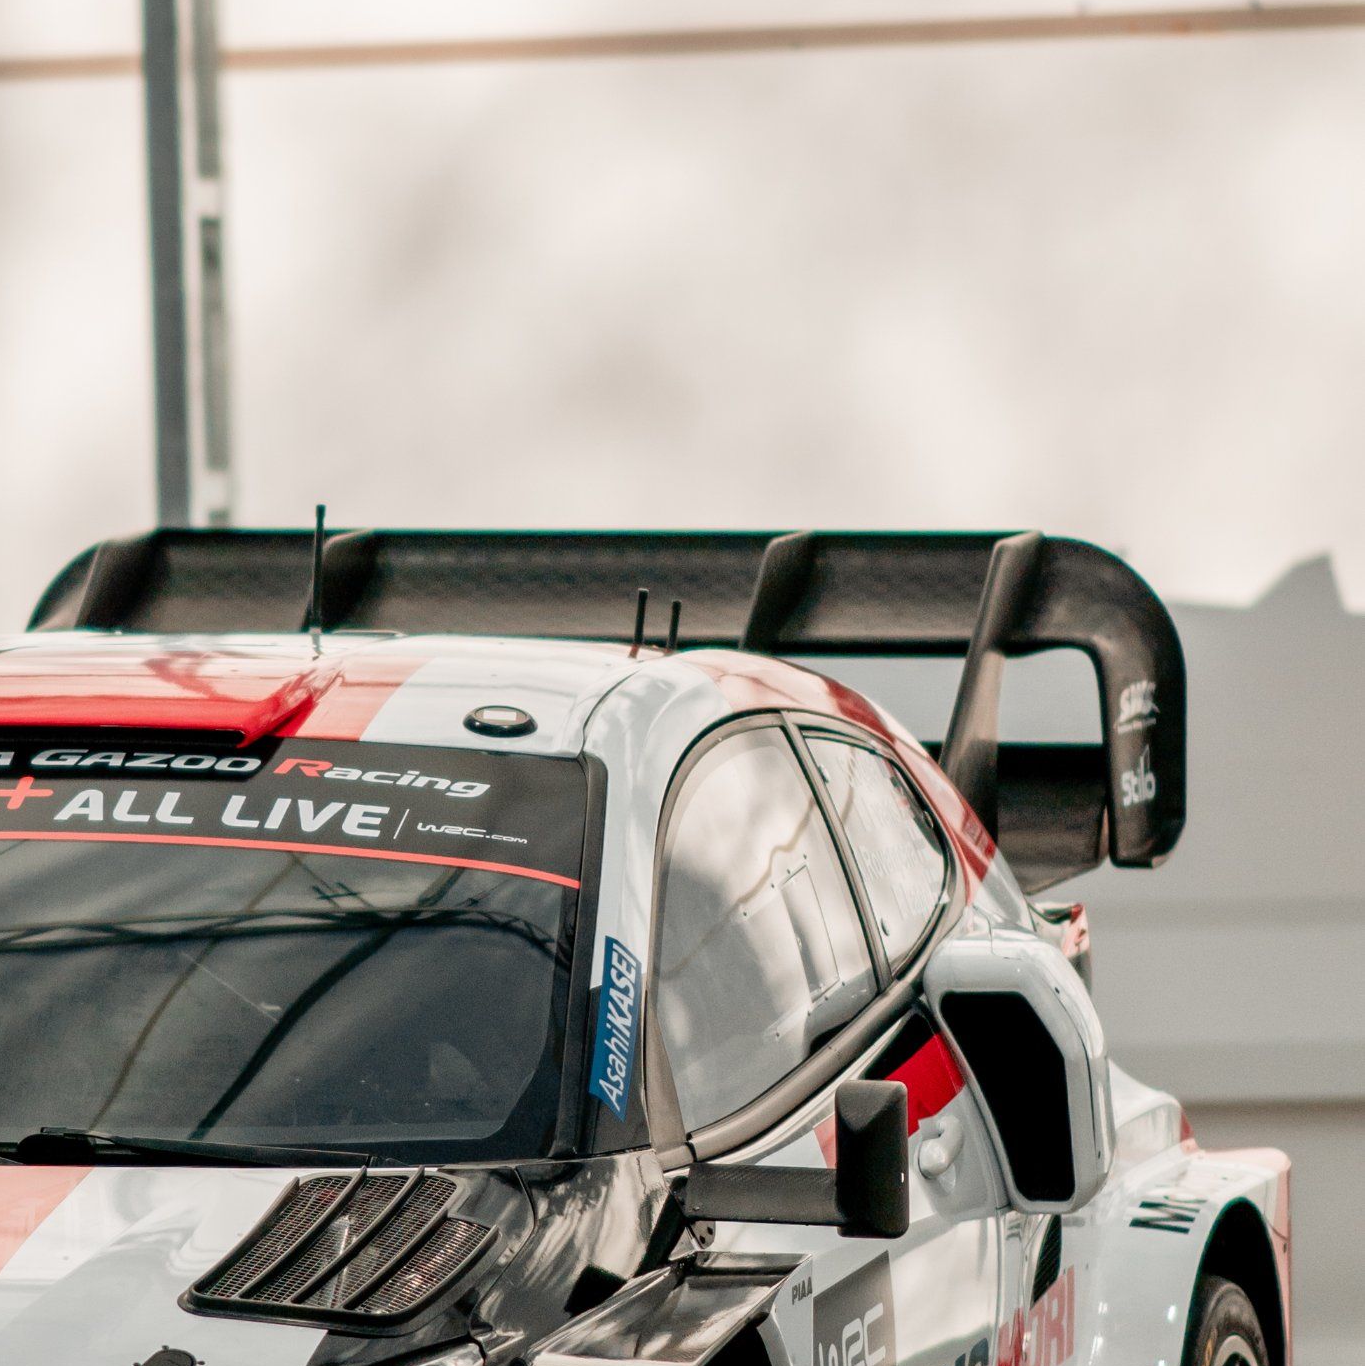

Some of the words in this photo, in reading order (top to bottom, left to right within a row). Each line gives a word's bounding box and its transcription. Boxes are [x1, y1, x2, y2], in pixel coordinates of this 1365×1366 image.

[31, 748, 262, 772] GAZOO
[273, 757, 491, 798] Racing
[53, 788, 195, 825] ALL
[221, 794, 390, 838] LIVE
